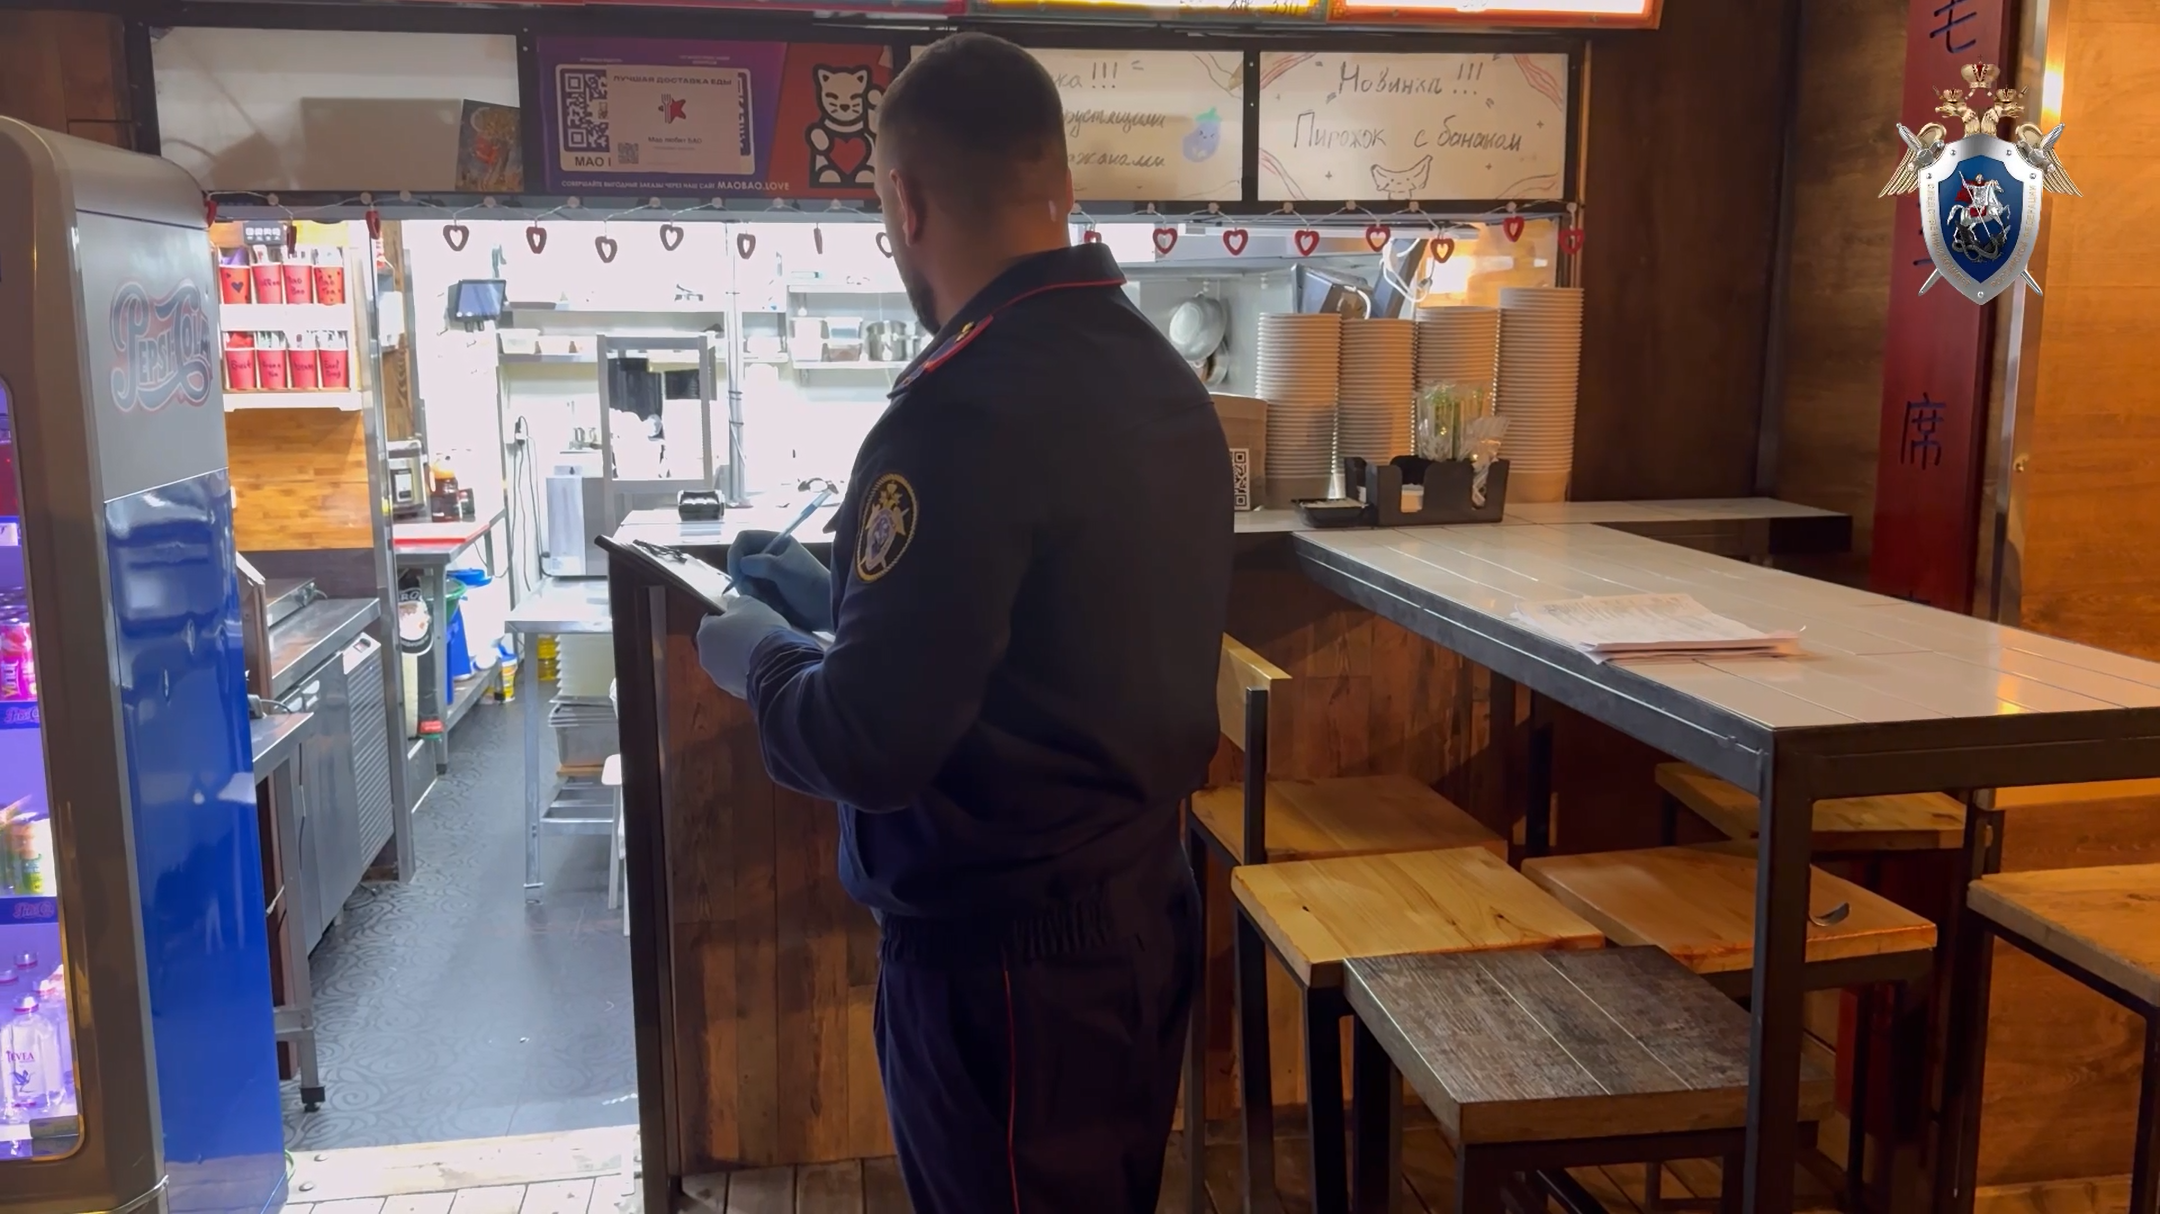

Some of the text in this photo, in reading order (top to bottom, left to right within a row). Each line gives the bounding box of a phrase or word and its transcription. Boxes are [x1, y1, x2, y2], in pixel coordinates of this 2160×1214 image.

[613, 75, 732, 86] ЛУЧШАЯ ДОСТАВКА ЕДЫ
[1339, 61, 1443, 95] Новинка
[1294, 109, 1387, 149] Пирожок
[717, 181, 790, 191] MAOBAO.LOVE
